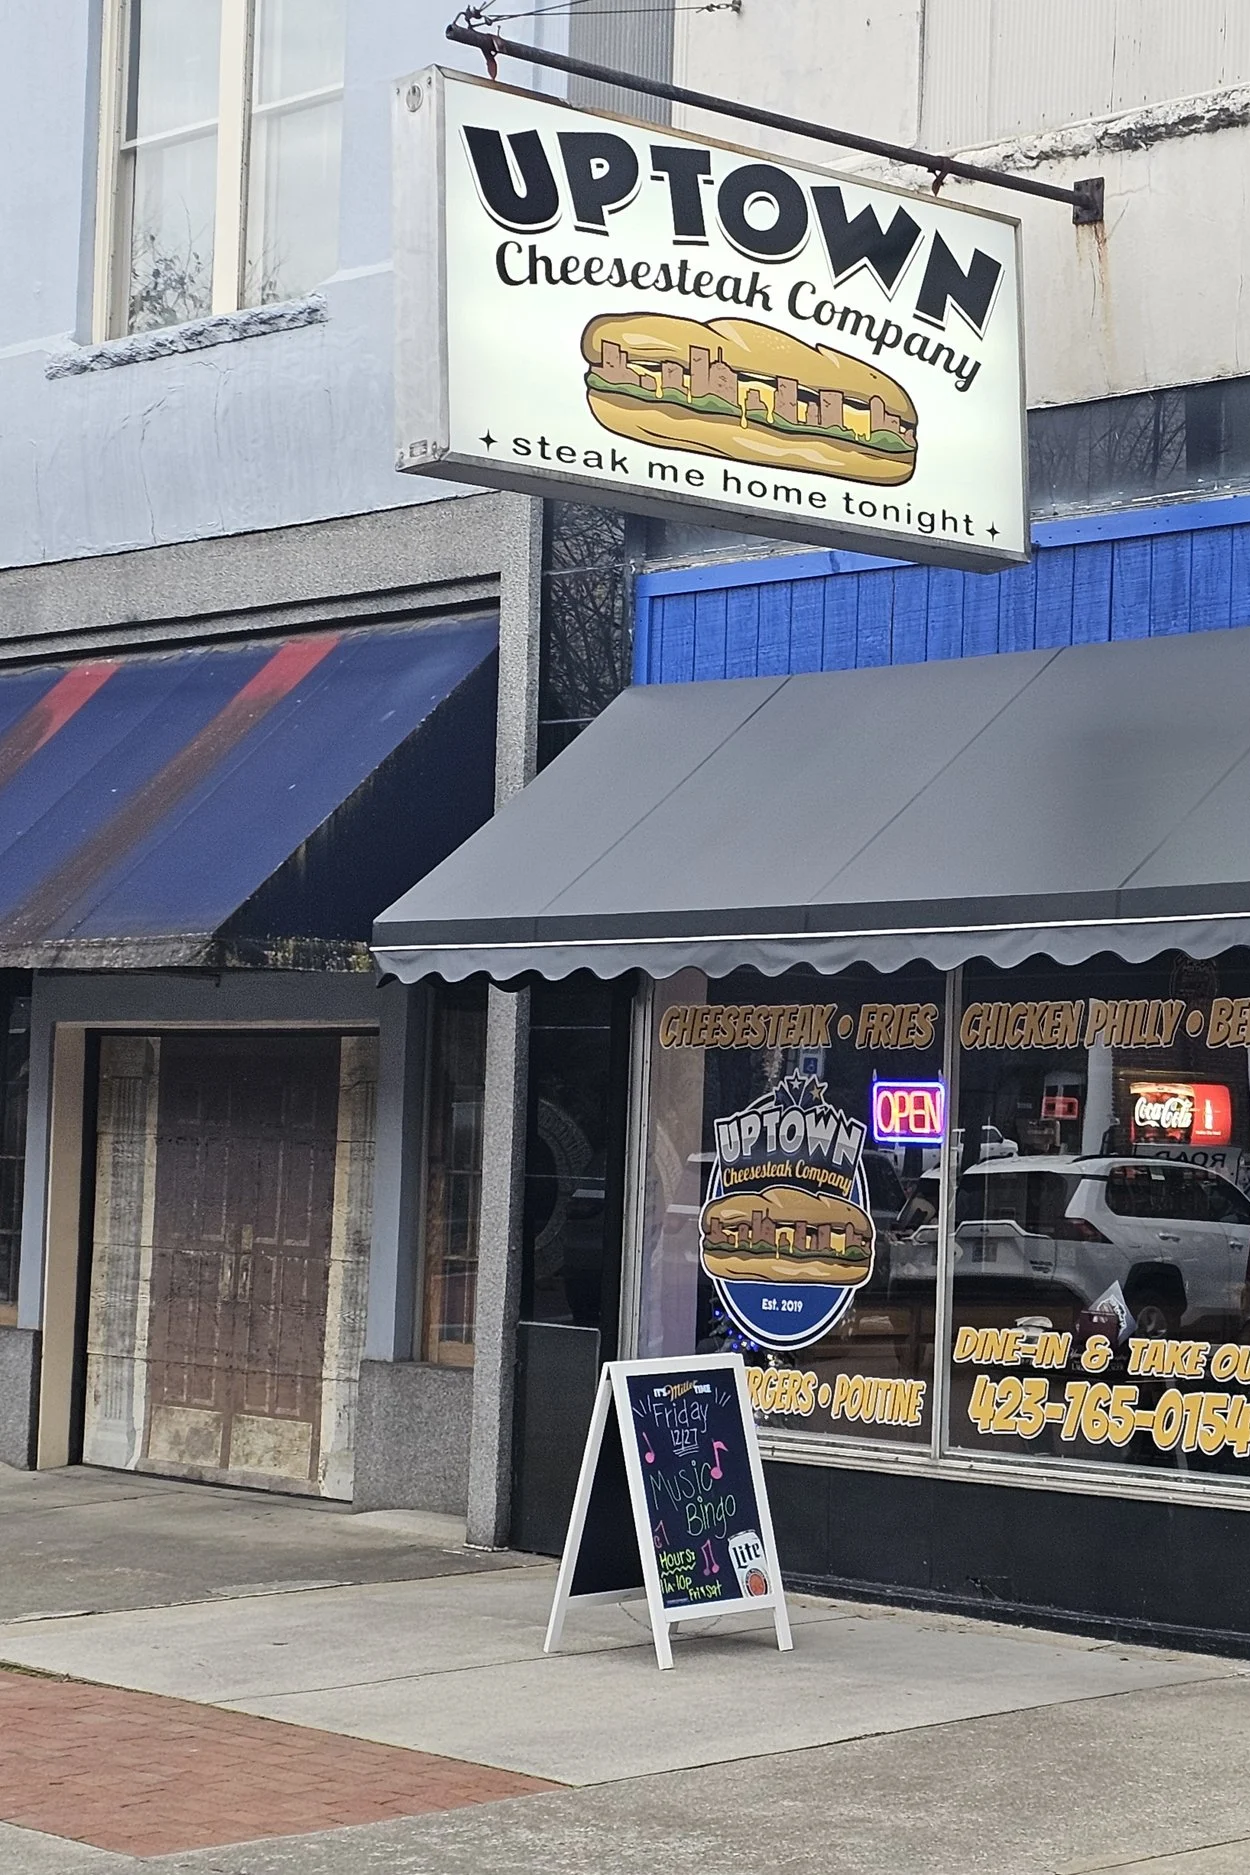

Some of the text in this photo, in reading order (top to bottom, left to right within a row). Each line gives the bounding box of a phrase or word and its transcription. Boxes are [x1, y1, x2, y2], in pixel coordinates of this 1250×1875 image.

[459, 125, 1005, 341] UPTOWN
[496, 241, 982, 392] Cheesesteak Company
[512, 436, 975, 534] steak me home tonight
[659, 1003, 939, 1050] CHEESESTEAK FRIES
[960, 1000, 1085, 1050] CHICKEN
[1084, 998, 1186, 1050] PHILLY
[716, 1106, 867, 1167] UPTOWN
[876, 1090, 942, 1134] OPEN
[723, 1159, 853, 1198] Cheesesteak Company
[762, 1299, 803, 1312] Est. 2019
[954, 1327, 1072, 1370] DINE-IN
[1081, 1333, 1113, 1373] &
[1127, 1338, 1210, 1380] TAKE
[652, 1399, 709, 1434] Friday
[745, 1366, 926, 1427] RGERS POUTINE
[670, 1428, 698, 1448] 12/27
[650, 1460, 712, 1512] Music
[686, 1495, 736, 1539] Bingo
[732, 1542, 761, 1570] Lite
